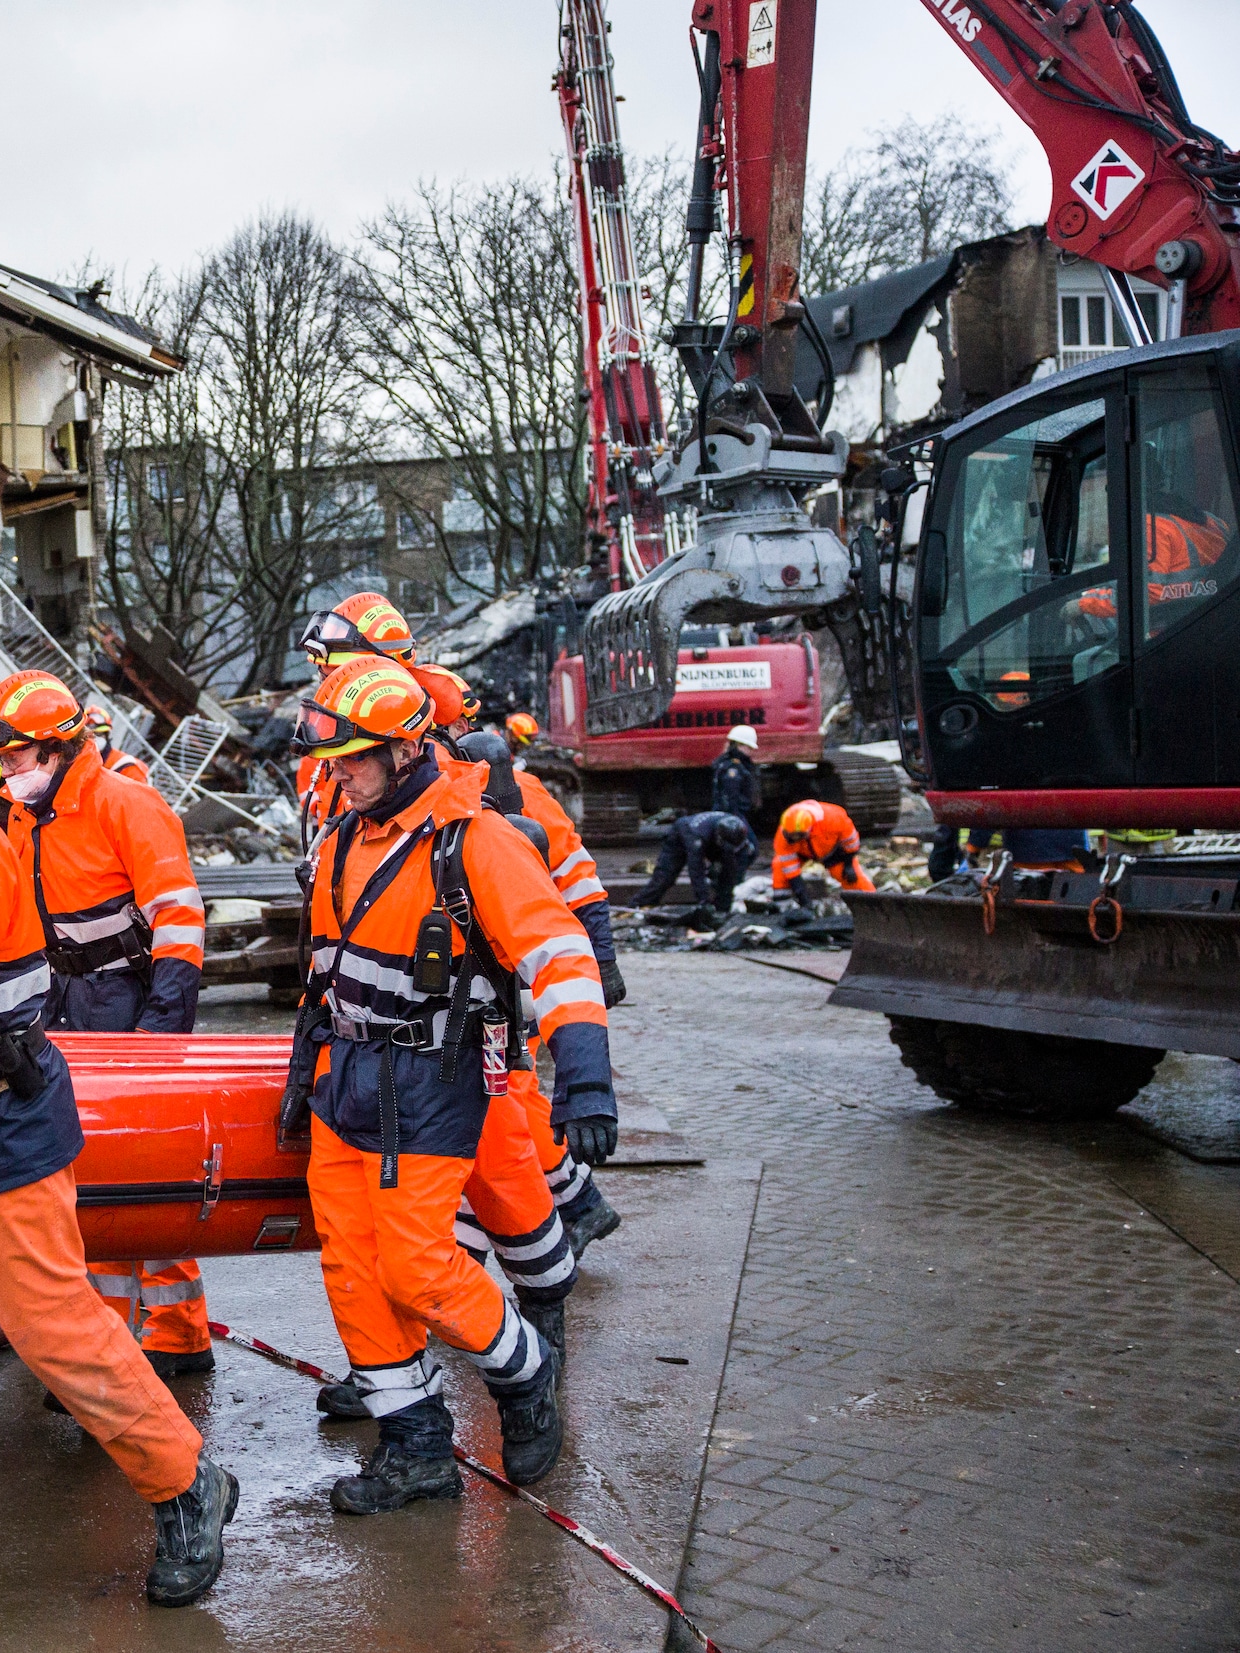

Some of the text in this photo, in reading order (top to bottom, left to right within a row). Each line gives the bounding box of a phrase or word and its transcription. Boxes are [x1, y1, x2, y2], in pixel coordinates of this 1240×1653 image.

[931, 0, 982, 42] LAS
[1160, 580, 1218, 600] ATLAS
[681, 668, 757, 680] NIJNENBURG
[367, 687, 393, 703] WALTER
